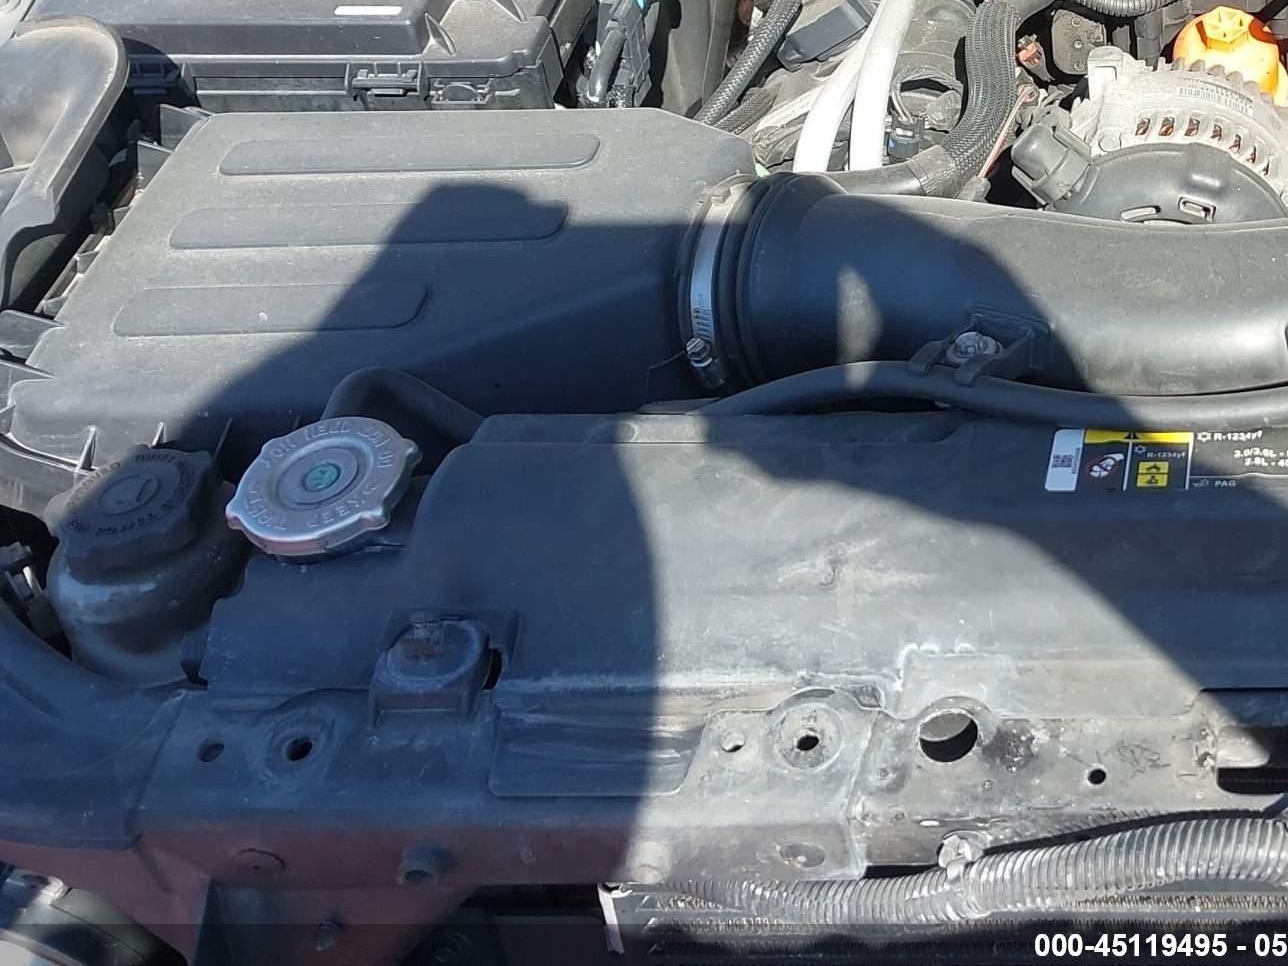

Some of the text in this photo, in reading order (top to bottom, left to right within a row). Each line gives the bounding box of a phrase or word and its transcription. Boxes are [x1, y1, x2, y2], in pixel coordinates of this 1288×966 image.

[1213, 429, 1263, 442] R-1234yf
[1147, 451, 1186, 459] R-1234yf
[1214, 479, 1237, 487] PAG
